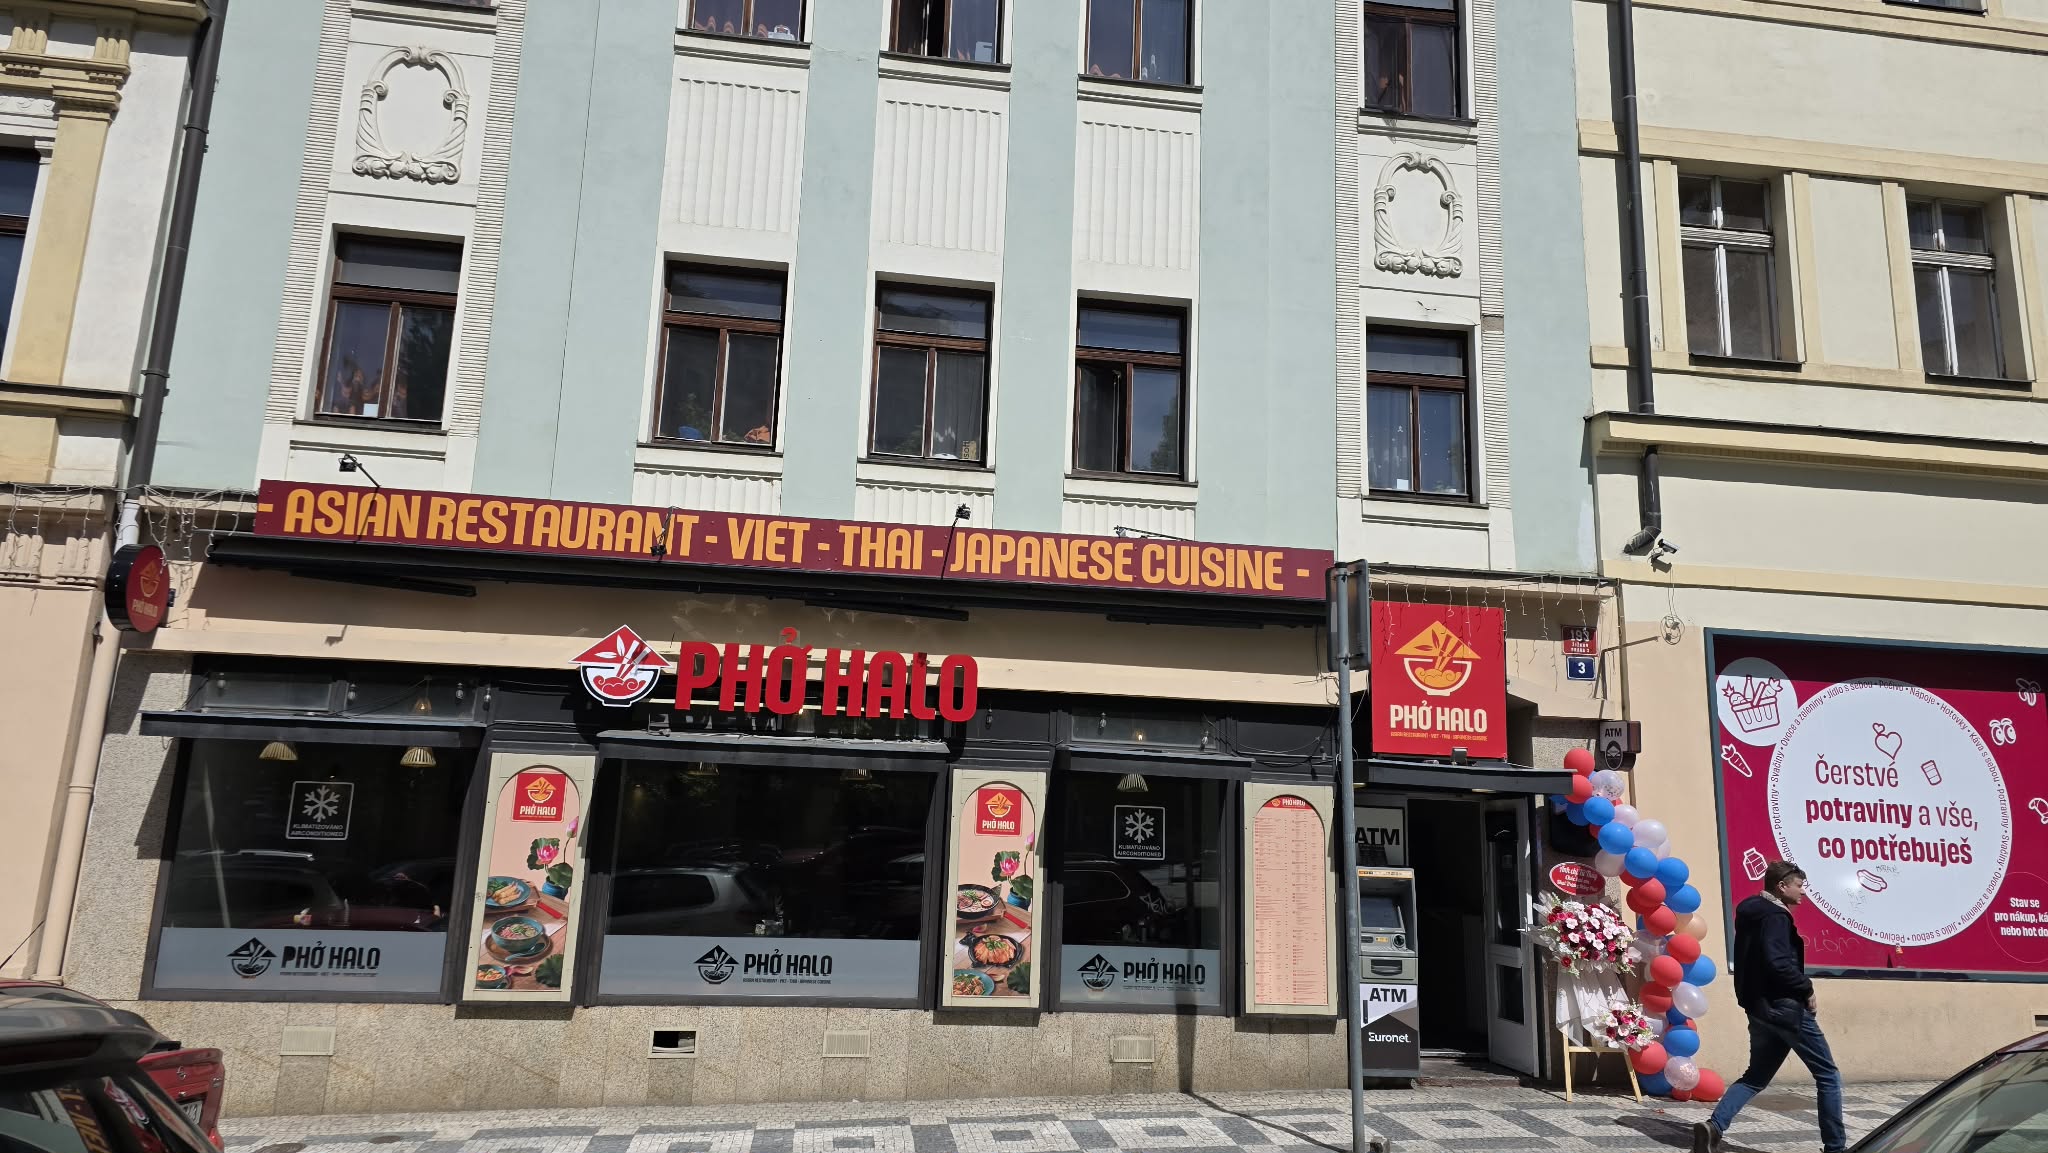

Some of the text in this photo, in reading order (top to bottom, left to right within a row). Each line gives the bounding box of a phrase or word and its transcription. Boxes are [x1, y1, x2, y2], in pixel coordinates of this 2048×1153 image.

[283, 488, 1284, 592] ASIAN RESTAURANT VIET THAI JAPANESE CUISINE
[674, 626, 978, 722] PHỞ HALO
[1577, 661, 1586, 675] 3
[1827, 686, 1844, 699] Jídlo
[1850, 681, 1873, 691] sebou
[1909, 687, 1936, 705] Nápoje
[1389, 700, 1488, 733] PHỞ HALO
[1797, 696, 1824, 721] zeleniny
[1940, 703, 1968, 730] Hotovky
[1604, 728, 1622, 738] ATM
[1781, 724, 1797, 747] Ovoce
[1969, 732, 1984, 752] Káva
[1815, 753, 1899, 788] Čerstvé
[1984, 757, 2000, 783] sebou
[537, 806, 557, 816] HALO
[1805, 798, 1978, 832] potraviny a vše,
[997, 820, 1015, 830] HALO
[1355, 827, 1400, 846] ATM
[1817, 833, 1973, 868] co potřebuješ
[1986, 871, 2002, 896] Ovoce
[1813, 891, 1842, 920] Hotovky
[1960, 898, 1986, 924] zeleniny
[2010, 897, 2040, 908] Stav se
[1846, 917, 1874, 937] Nápoje
[1994, 912, 2009, 923] pro
[2010, 911, 2038, 924] nákup,
[1879, 931, 1906, 944] Pečivo
[1911, 931, 1935, 943] sebou
[2001, 926, 2022, 936] nebo
[2022, 926, 2038, 937] hot
[280, 940, 381, 970] PHỞ HALO
[743, 949, 833, 977] PHỞ HALO
[1123, 957, 1206, 985] PHỞ HALO
[1369, 987, 1408, 1003] ATM
